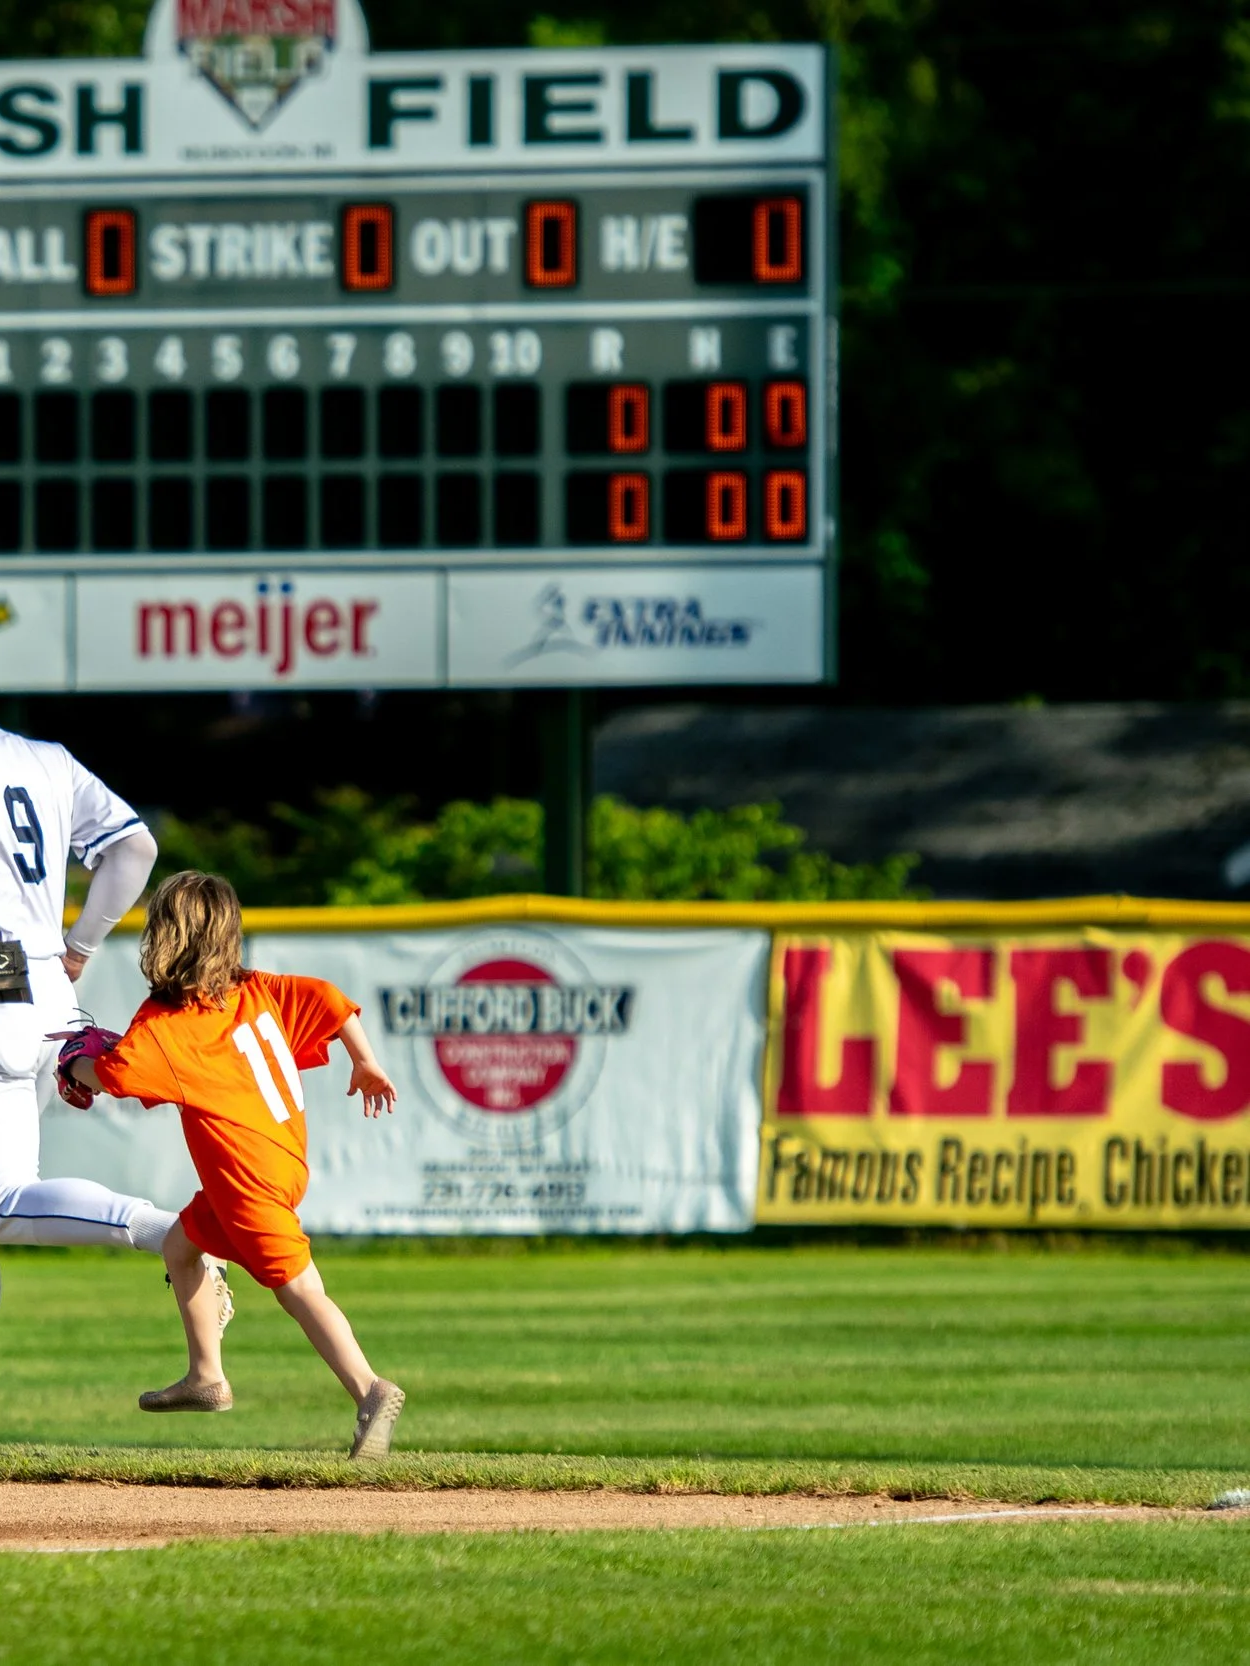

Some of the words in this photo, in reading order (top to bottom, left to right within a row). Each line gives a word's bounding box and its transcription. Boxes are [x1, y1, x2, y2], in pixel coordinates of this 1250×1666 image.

[366, 68, 808, 150] FIELD
[85, 210, 136, 295] 0
[151, 222, 334, 281] STRIKE
[342, 205, 393, 290] 0
[411, 218, 516, 275] OUT
[525, 202, 576, 287] 0
[601, 215, 688, 272] H/E
[753, 198, 802, 283] 0
[40, 338, 71, 383] 2
[96, 337, 129, 382] 3
[155, 336, 187, 380] 4
[211, 335, 243, 381] 5
[267, 334, 299, 378] 6
[326, 334, 356, 378] 7
[384, 332, 416, 377] 8
[442, 331, 474, 376] 9
[490, 330, 542, 376] 10
[591, 328, 624, 372] R
[689, 327, 721, 371] H
[768, 326, 798, 370] E
[608, 384, 649, 453] 0
[706, 383, 747, 451] 0
[764, 382, 806, 447] 0
[608, 473, 649, 541] 0
[706, 472, 747, 540] 0
[764, 470, 806, 540] 0
[137, 578, 377, 676] meijer
[3, 784, 47, 886] 9
[395, 986, 538, 1034] CLIFFORD
[544, 985, 626, 1034] BUCK
[776, 938, 1250, 1122] LEE'S
[232, 1011, 305, 1124] 11
[767, 1133, 922, 1204] Famous
[934, 1137, 1077, 1220] Recipe
[1102, 1134, 1250, 1207] Chicke
